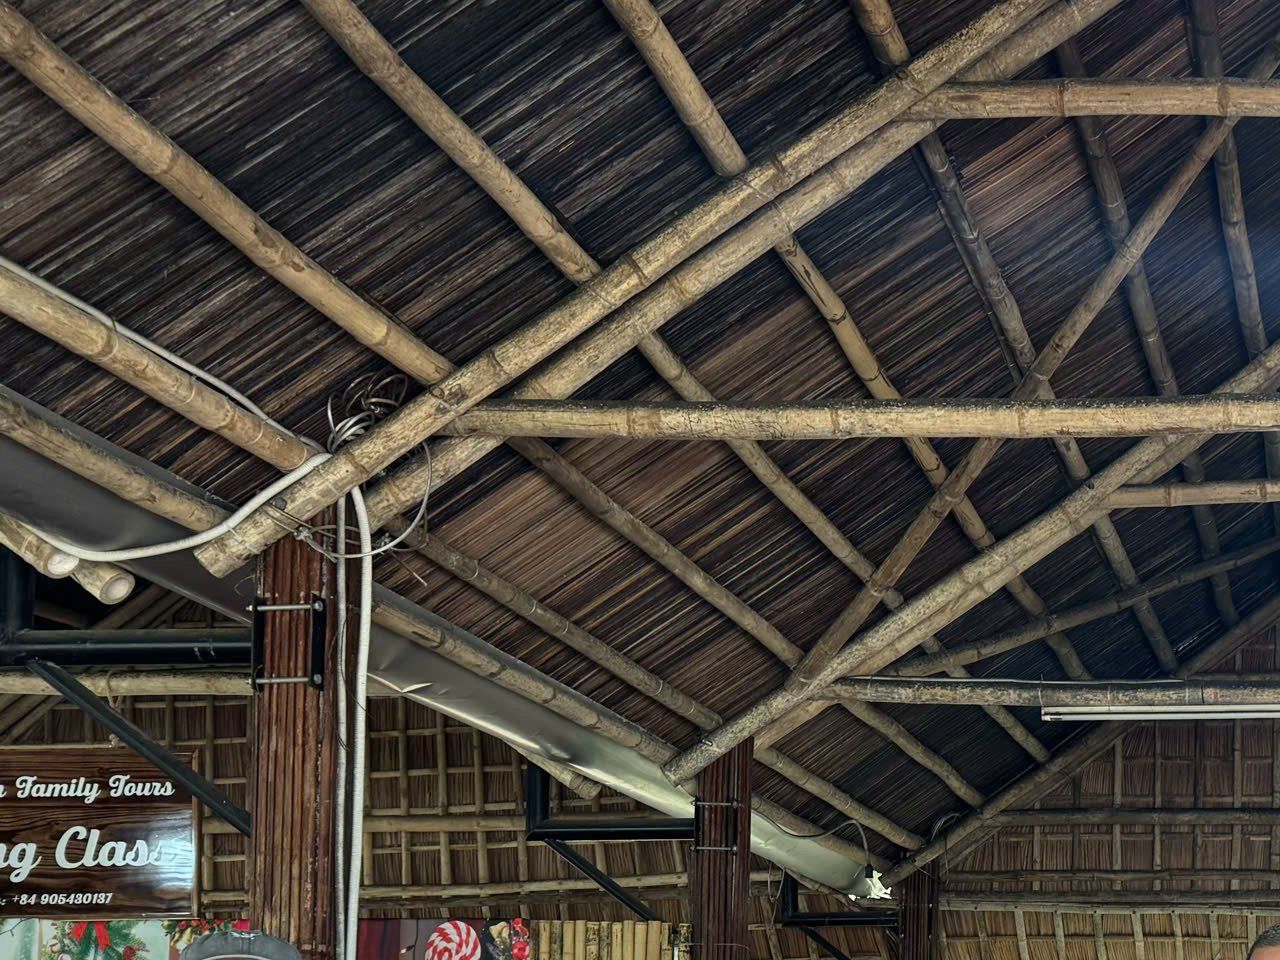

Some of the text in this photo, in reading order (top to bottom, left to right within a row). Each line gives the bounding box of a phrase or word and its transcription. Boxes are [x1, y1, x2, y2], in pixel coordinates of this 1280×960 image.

[15, 775, 101, 804] Family
[109, 774, 175, 798] Tours
[12, 893, 37, 905] +84
